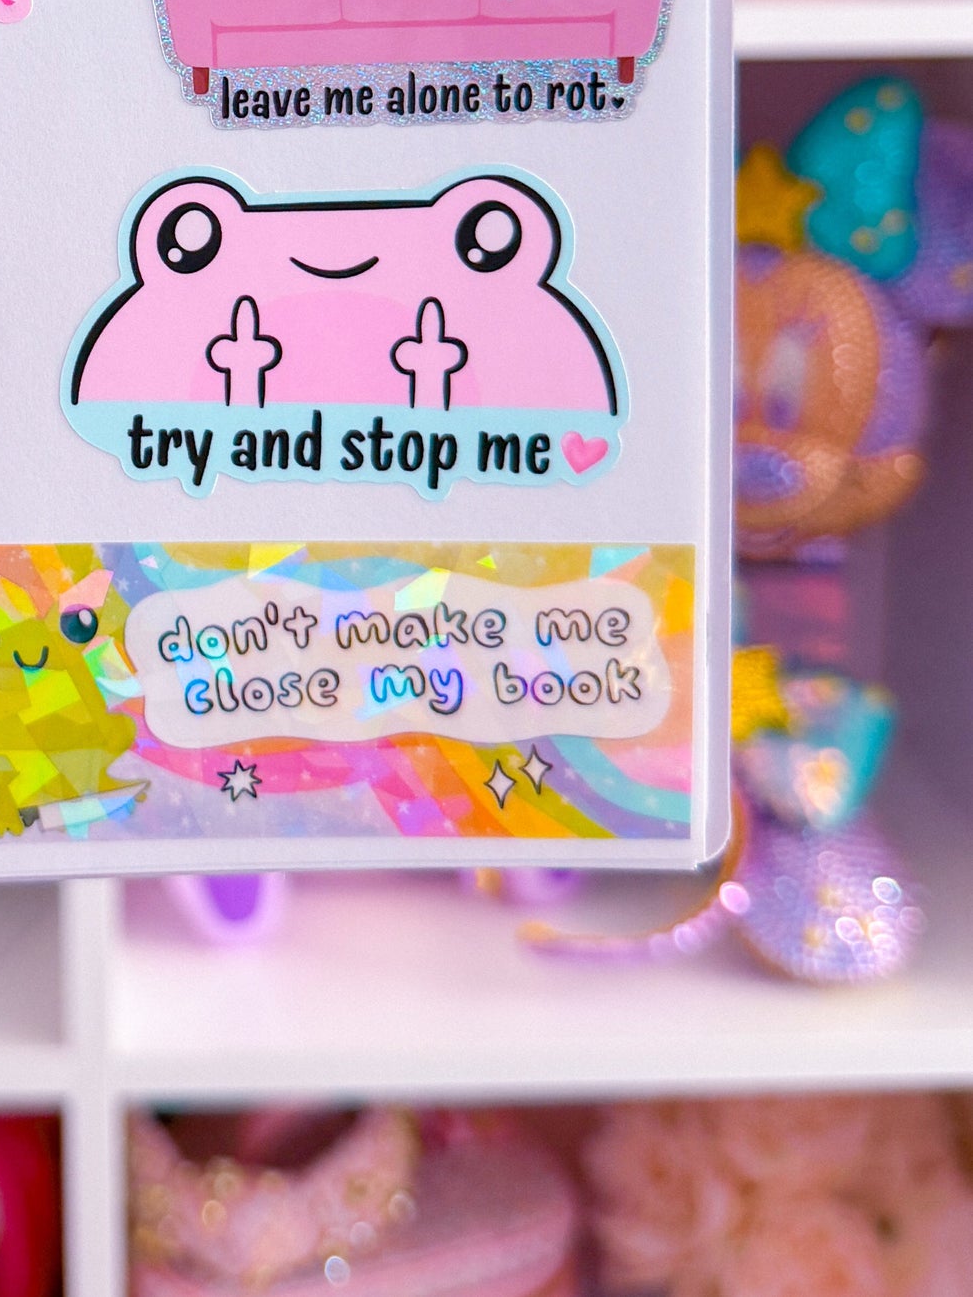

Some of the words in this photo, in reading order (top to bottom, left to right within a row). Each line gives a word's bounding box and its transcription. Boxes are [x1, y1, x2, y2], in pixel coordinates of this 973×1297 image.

[221, 76, 311, 119] leave
[326, 83, 374, 116] me
[386, 71, 481, 115] alone
[493, 74, 533, 112] to
[127, 414, 213, 487] try
[231, 409, 322, 471] and
[339, 416, 458, 490] stop
[477, 431, 550, 474] me
[158, 601, 317, 663] don't
[335, 602, 507, 650] make
[535, 606, 629, 648] me
[184, 666, 340, 715] close
[370, 663, 464, 715] my
[493, 658, 642, 705] book
